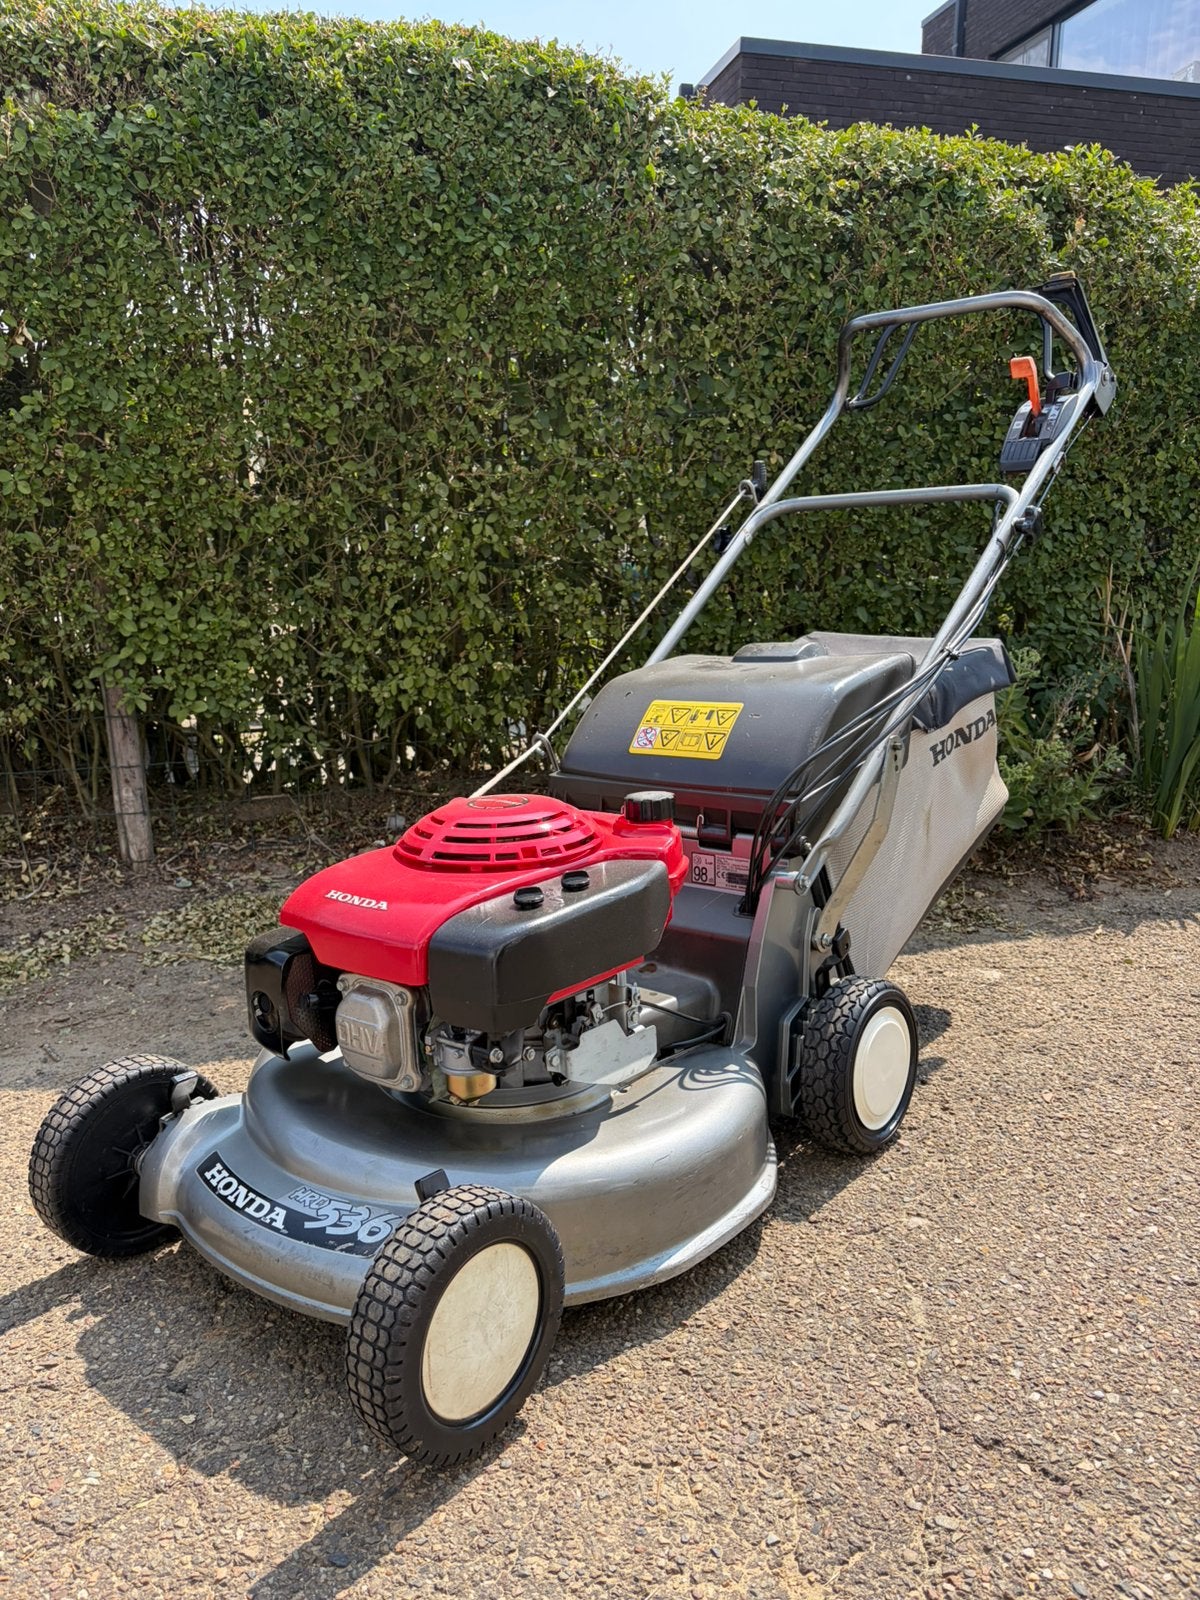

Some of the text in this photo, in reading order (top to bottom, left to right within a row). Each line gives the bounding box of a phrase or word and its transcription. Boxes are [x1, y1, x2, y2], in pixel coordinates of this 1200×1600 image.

[929, 709, 996, 767] HONDA
[693, 866, 708, 882] 98
[717, 871, 726, 879] CE
[324, 889, 388, 910] HONDA
[204, 1163, 287, 1230] HONDA
